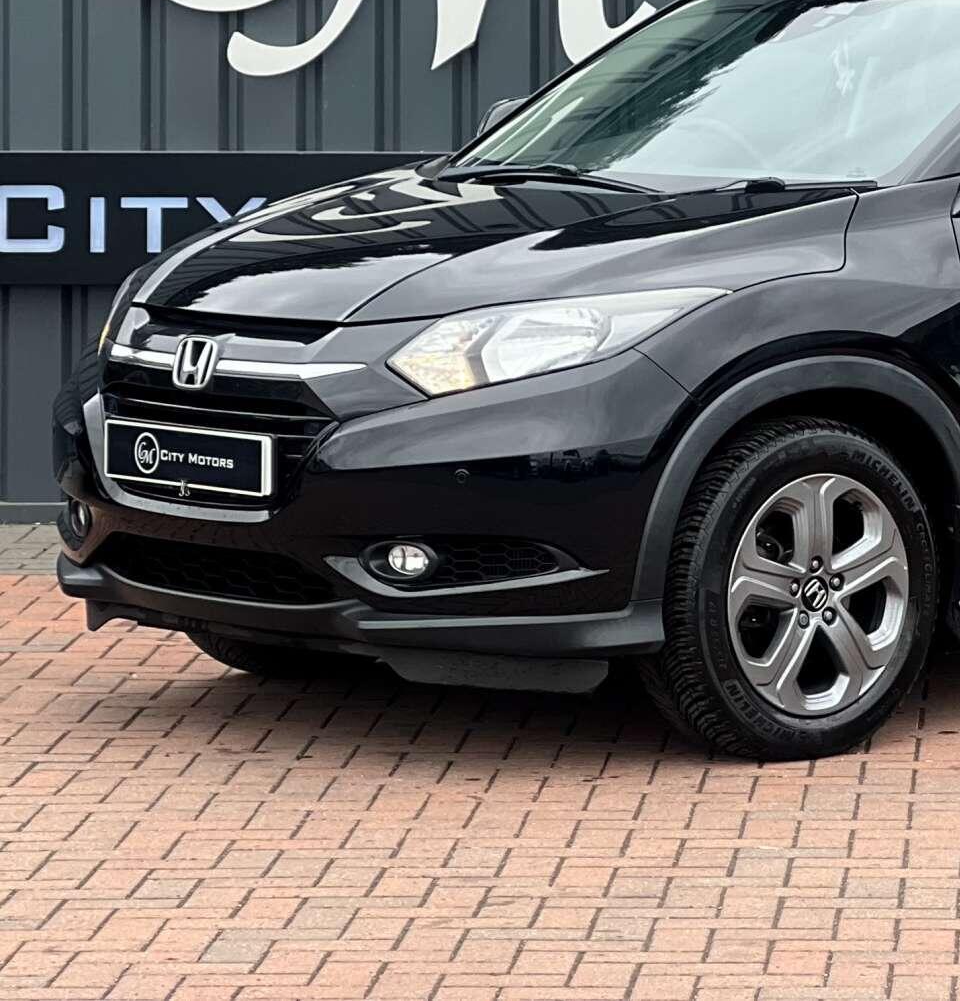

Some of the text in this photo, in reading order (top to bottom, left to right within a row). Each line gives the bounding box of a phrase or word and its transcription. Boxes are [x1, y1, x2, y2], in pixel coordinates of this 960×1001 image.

[160, 449, 185, 463] CITY
[187, 452, 234, 469] MOTORS
[853, 450, 917, 512] MICHELIN
